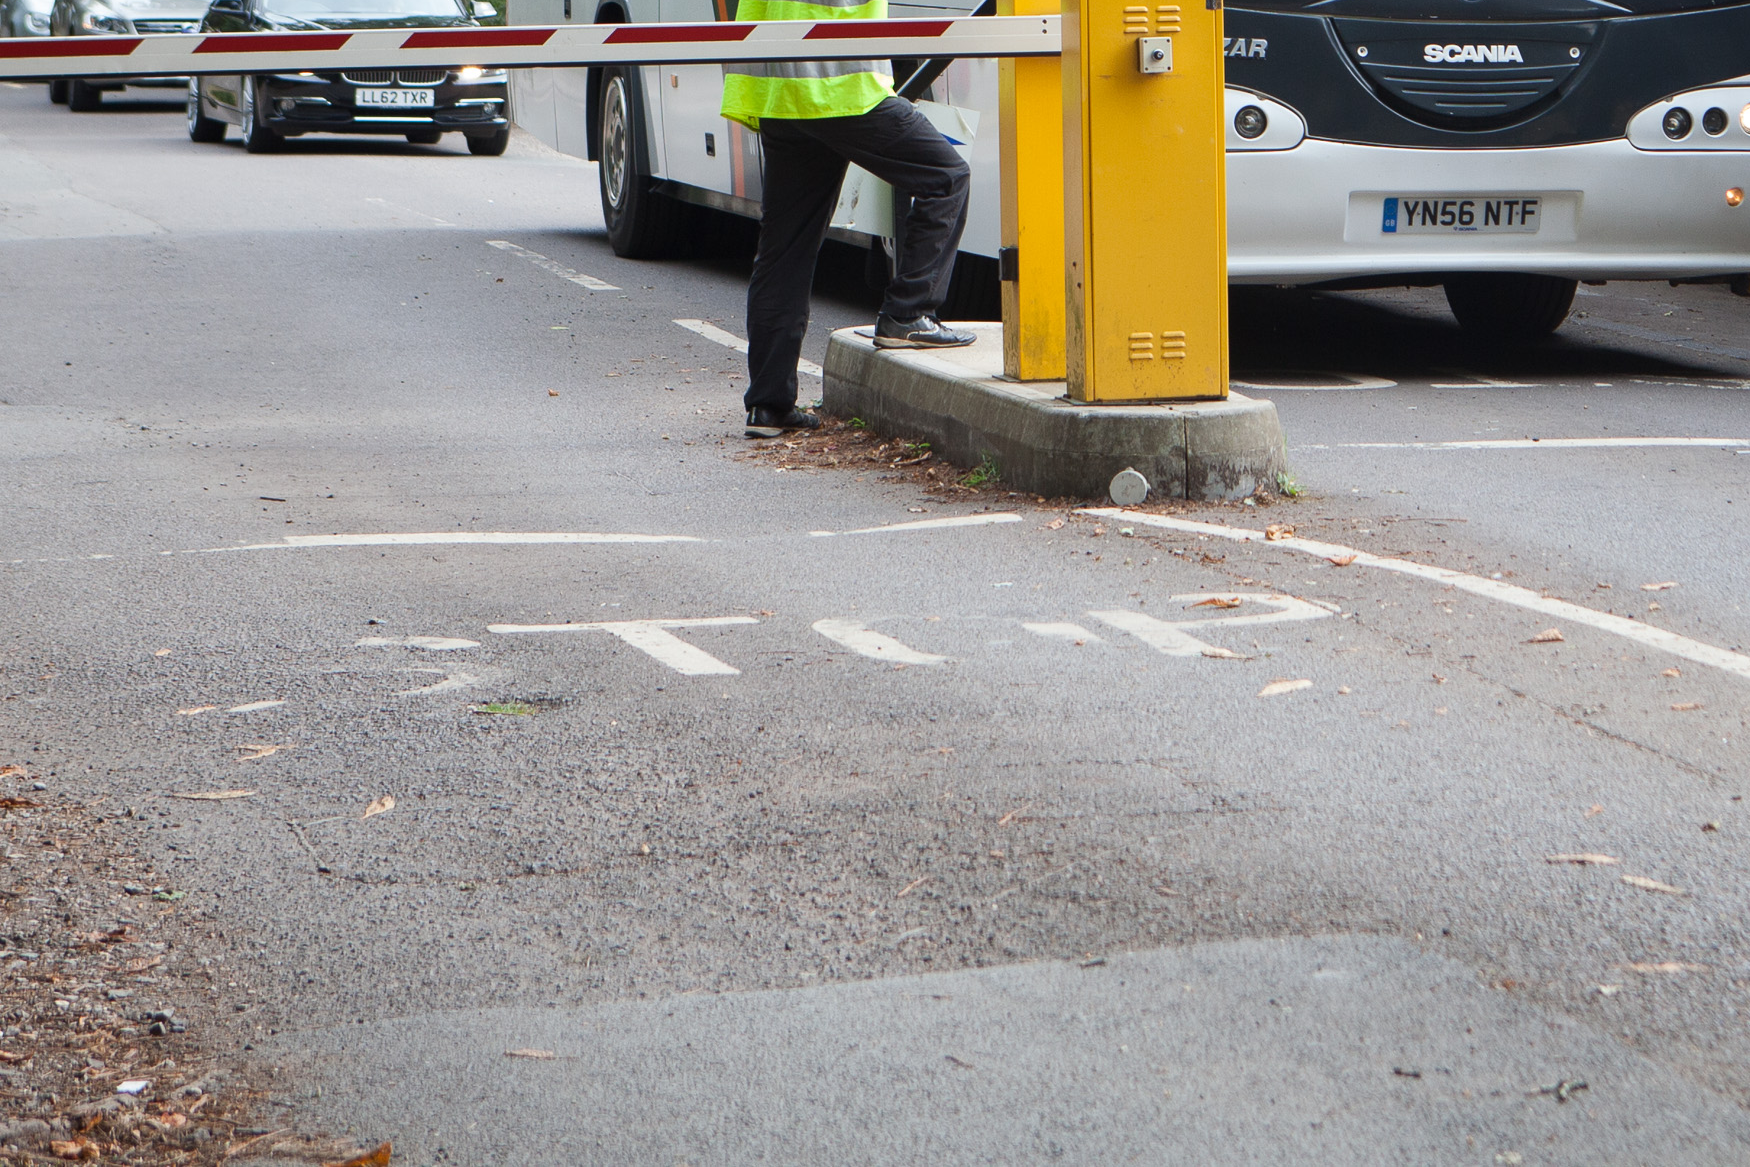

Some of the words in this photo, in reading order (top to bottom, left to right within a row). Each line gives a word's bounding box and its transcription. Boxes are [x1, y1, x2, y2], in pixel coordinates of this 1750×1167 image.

[1423, 44, 1524, 63] SCANIA
[362, 90, 398, 104] LL62
[402, 90, 428, 104] TXR
[1403, 200, 1475, 227] YN56
[1484, 200, 1539, 226] NTF
[1384, 219, 1396, 227] GB
